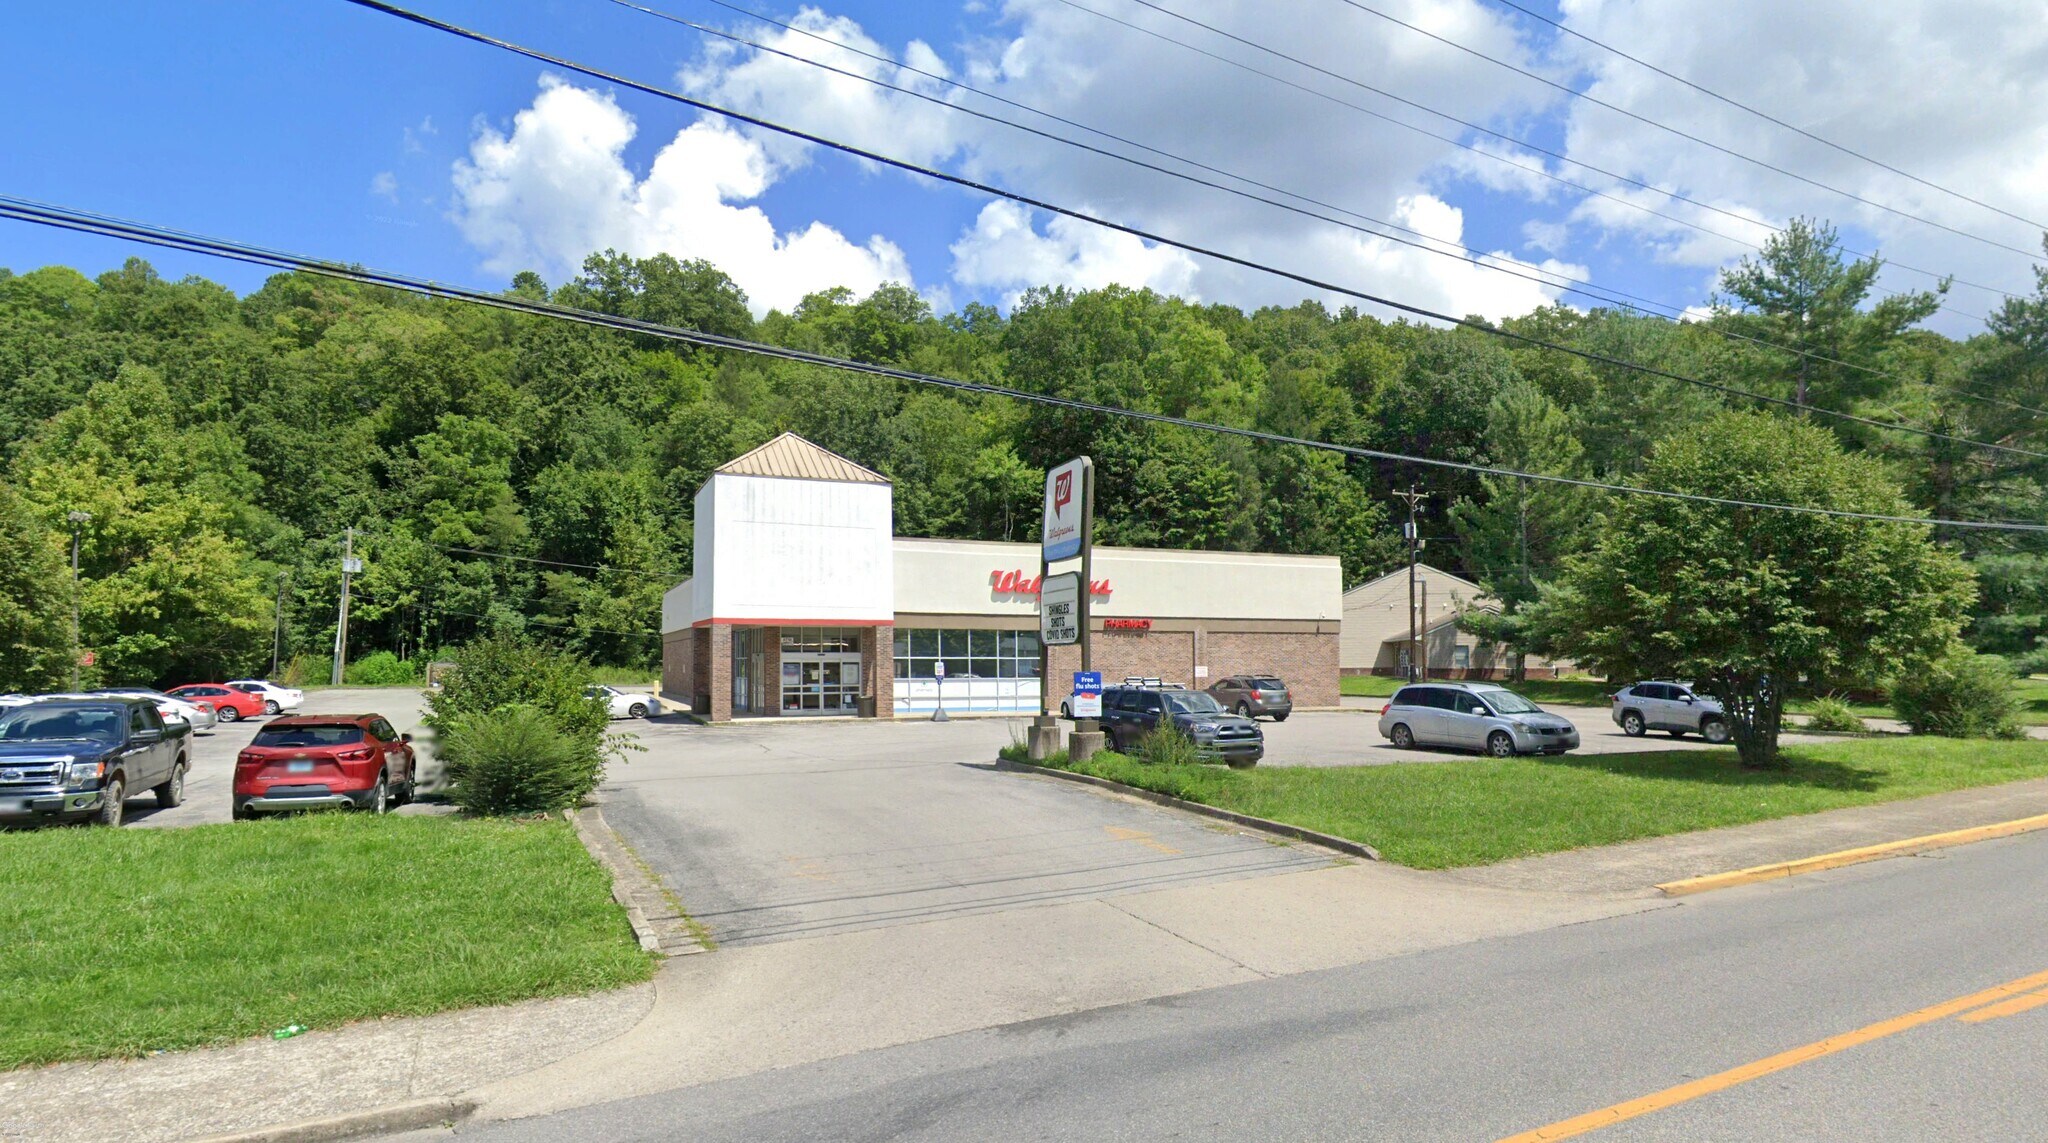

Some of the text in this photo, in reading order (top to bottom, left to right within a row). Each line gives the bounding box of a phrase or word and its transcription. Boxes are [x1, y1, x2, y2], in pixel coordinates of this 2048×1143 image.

[991, 569, 1113, 602] Walns
[1049, 604, 1069, 615] SHINGLES
[1051, 617, 1065, 627] SHOTS
[1105, 619, 1152, 628] PHARMACY
[1047, 628, 1075, 640] COVID SHOTS
